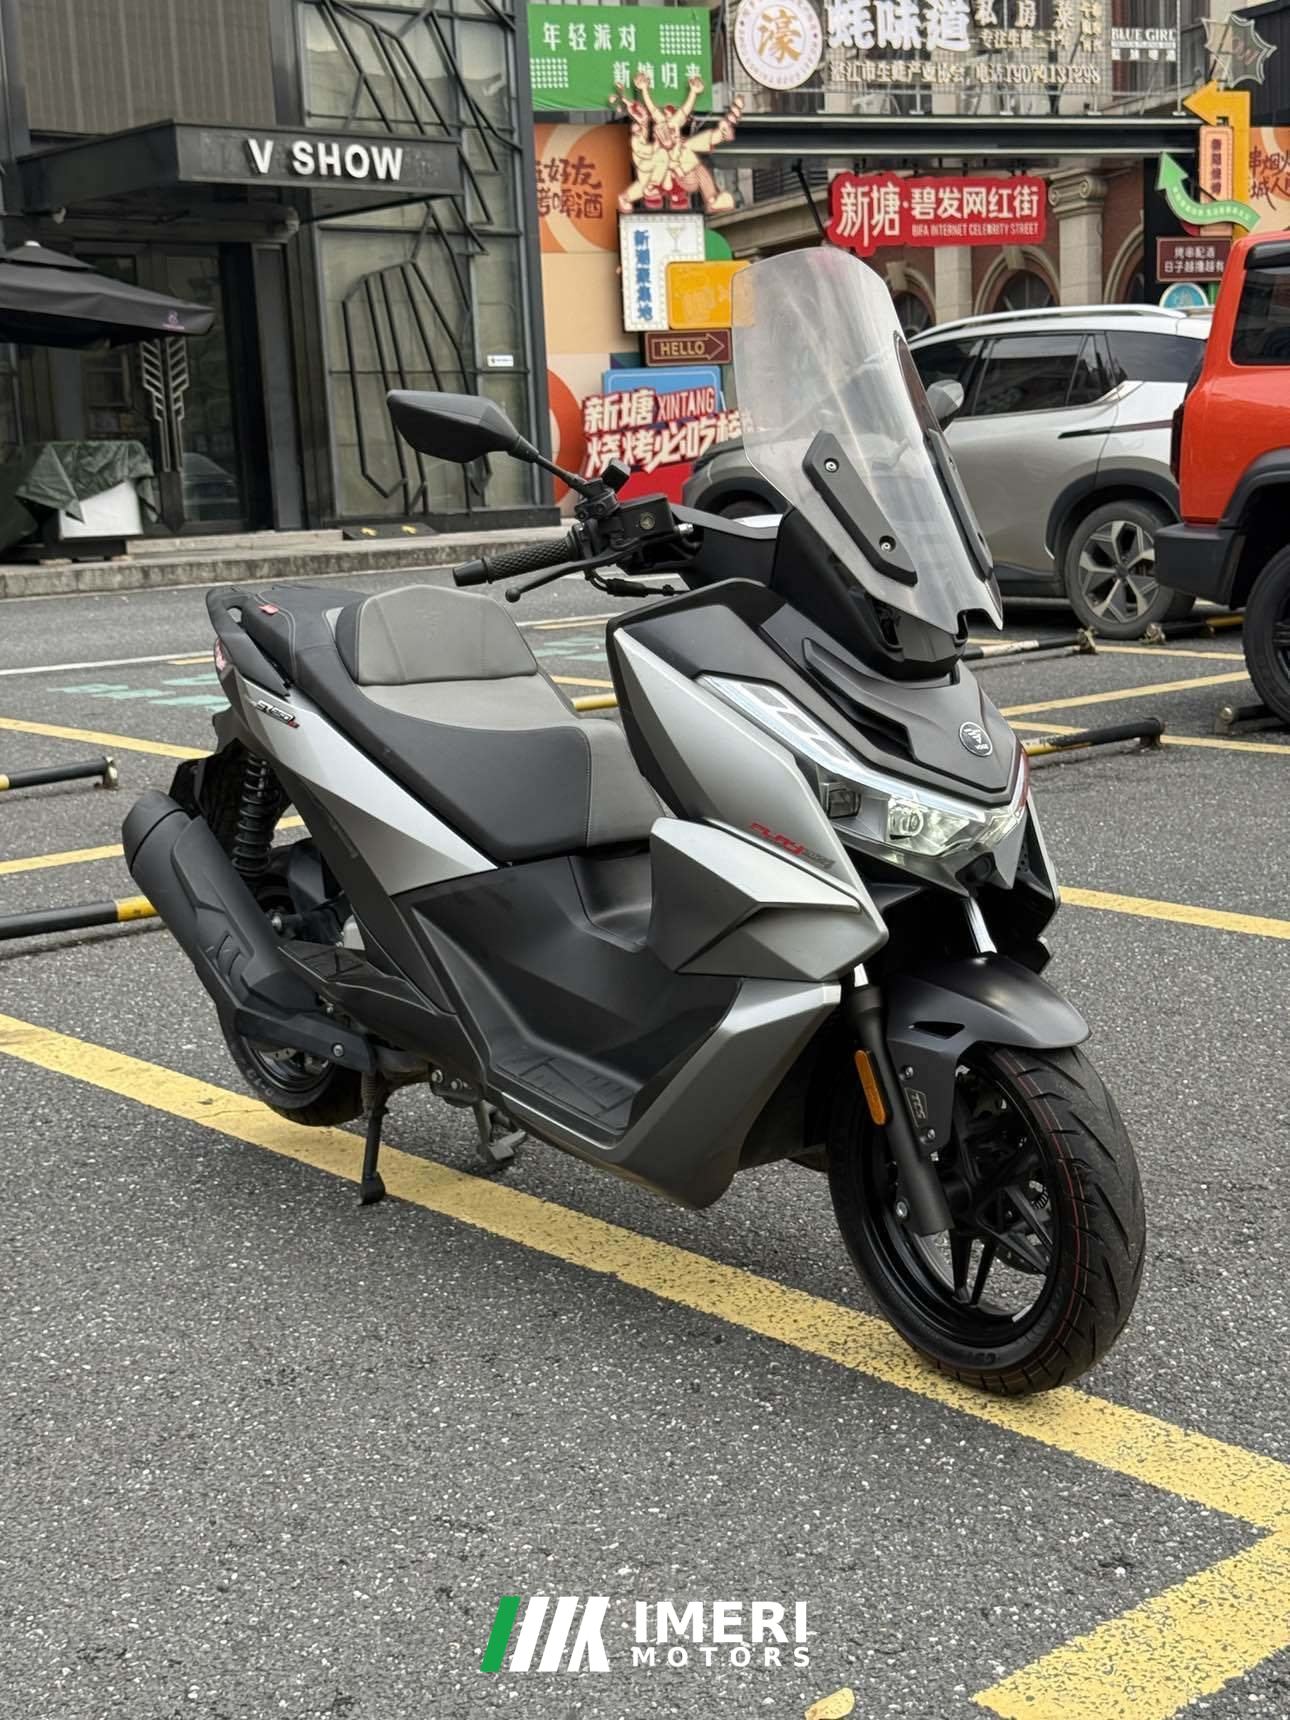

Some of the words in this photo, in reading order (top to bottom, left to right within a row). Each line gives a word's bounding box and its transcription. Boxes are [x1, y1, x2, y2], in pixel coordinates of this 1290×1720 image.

[543, 22, 636, 52] 年轻派对
[1111, 28, 1142, 40] BLUE
[1145, 28, 1176, 41] GIRL
[247, 139, 274, 174] V
[292, 141, 403, 181] SHOW
[931, 223, 967, 236] INTERNET
[968, 223, 1009, 236] CELEBRITY
[1011, 221, 1038, 235] STREET
[660, 341, 705, 356] HELLO
[585, 389, 655, 433] 新塘
[657, 388, 715, 421] XINTANG
